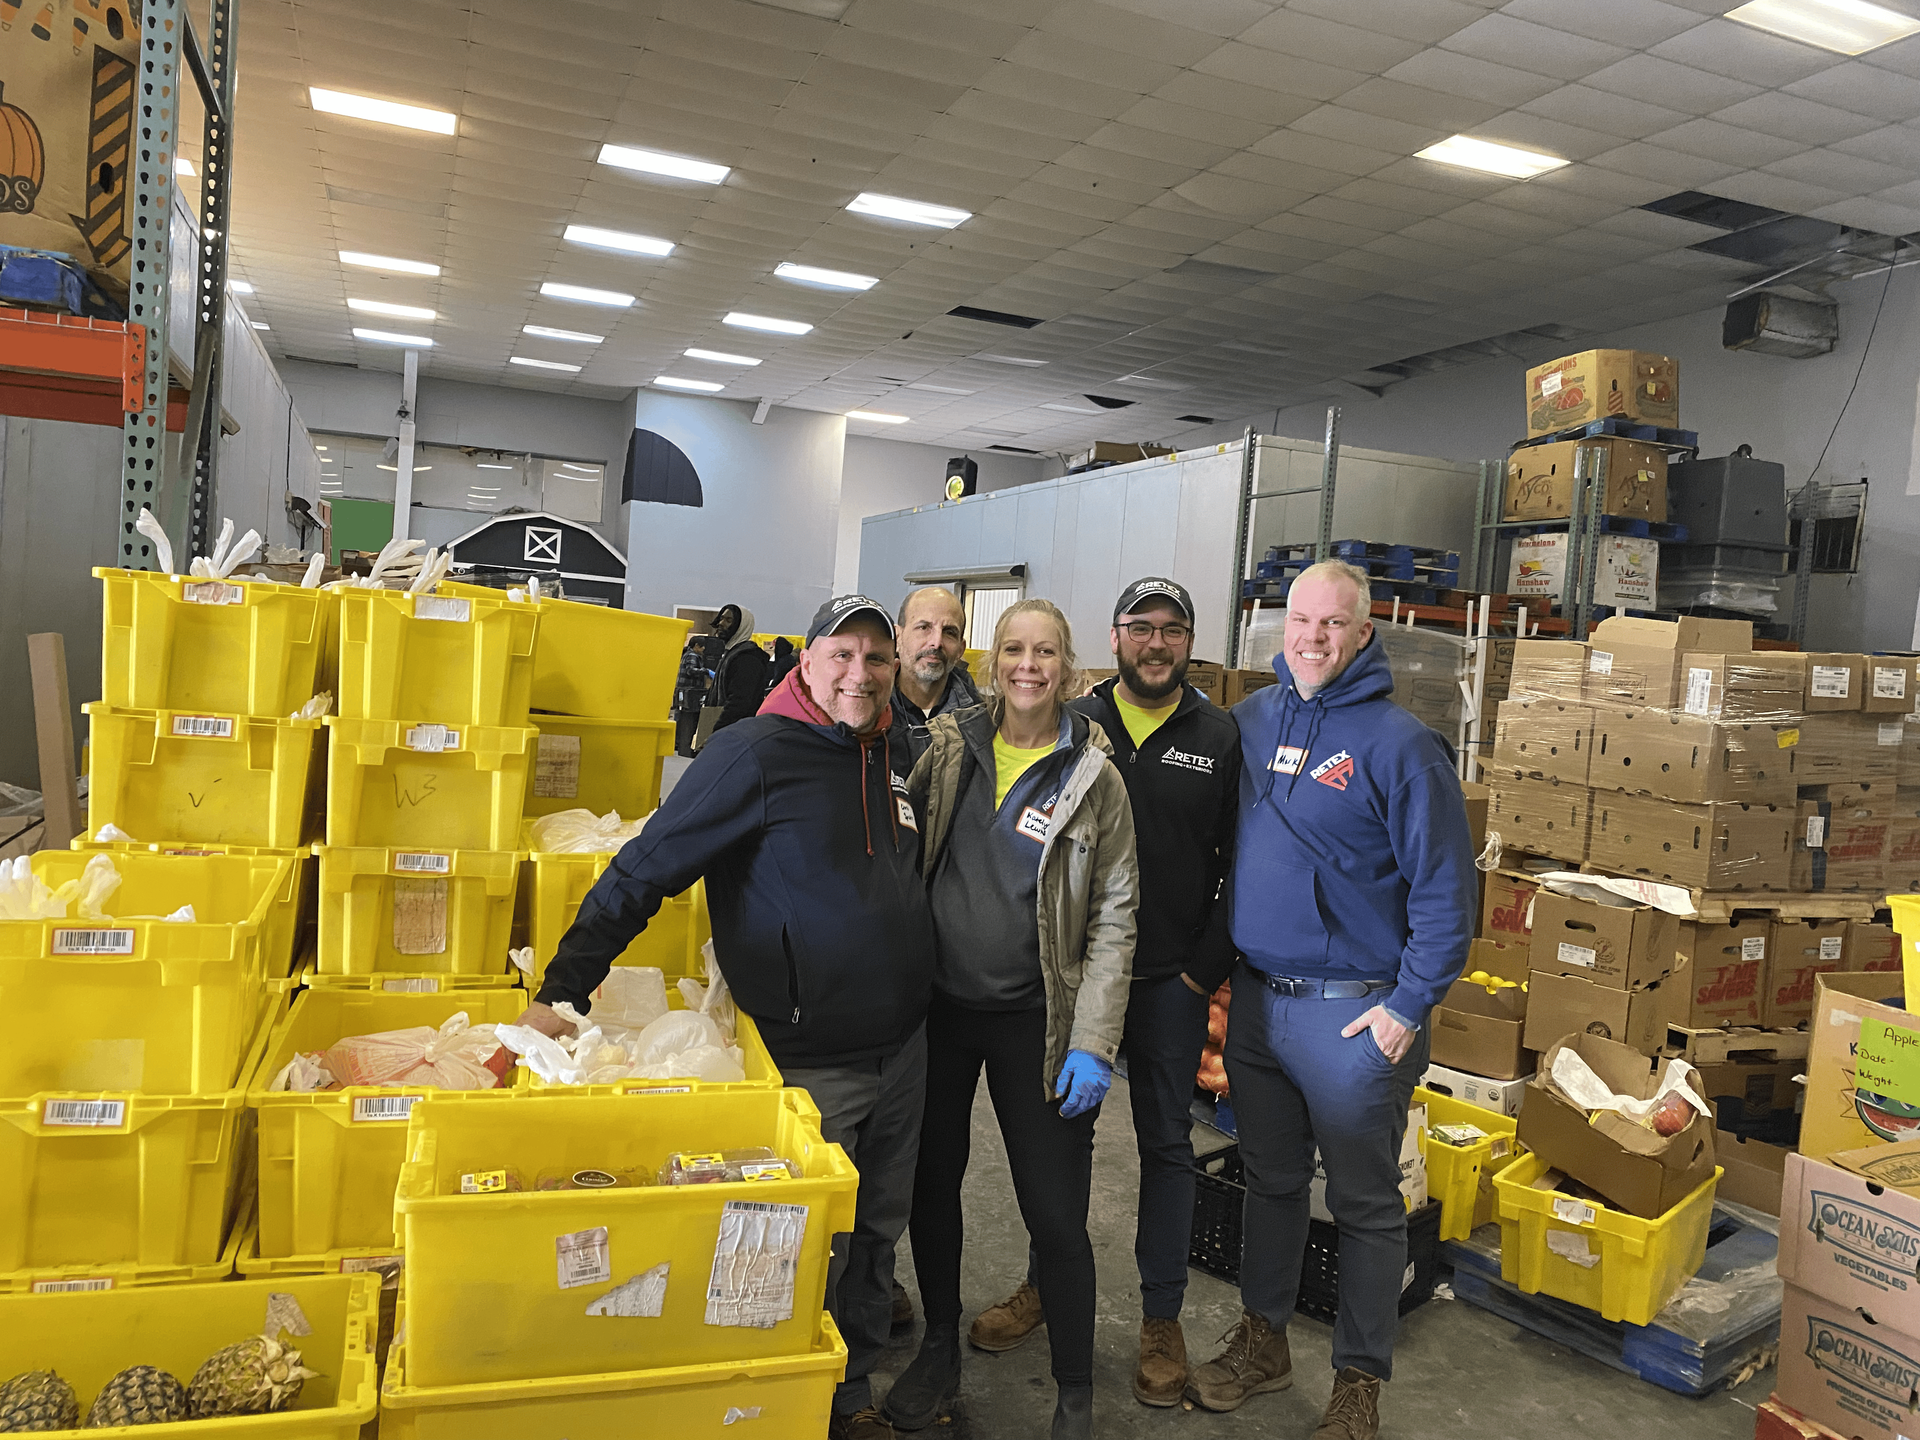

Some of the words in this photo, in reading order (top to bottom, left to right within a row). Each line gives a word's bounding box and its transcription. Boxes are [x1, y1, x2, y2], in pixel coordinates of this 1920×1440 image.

[1517, 578, 1550, 586] Hanshaw
[1618, 578, 1649, 587] Hanshaw
[1884, 1027, 1920, 1048] Apple
[1821, 1203, 1879, 1241] OCEAN
[1875, 1226, 1920, 1257] MIS
[1833, 1252, 1908, 1292] VEGETABLES
[1817, 1330, 1873, 1370] OCEAN
[1826, 1379, 1866, 1405] PRODUCE
